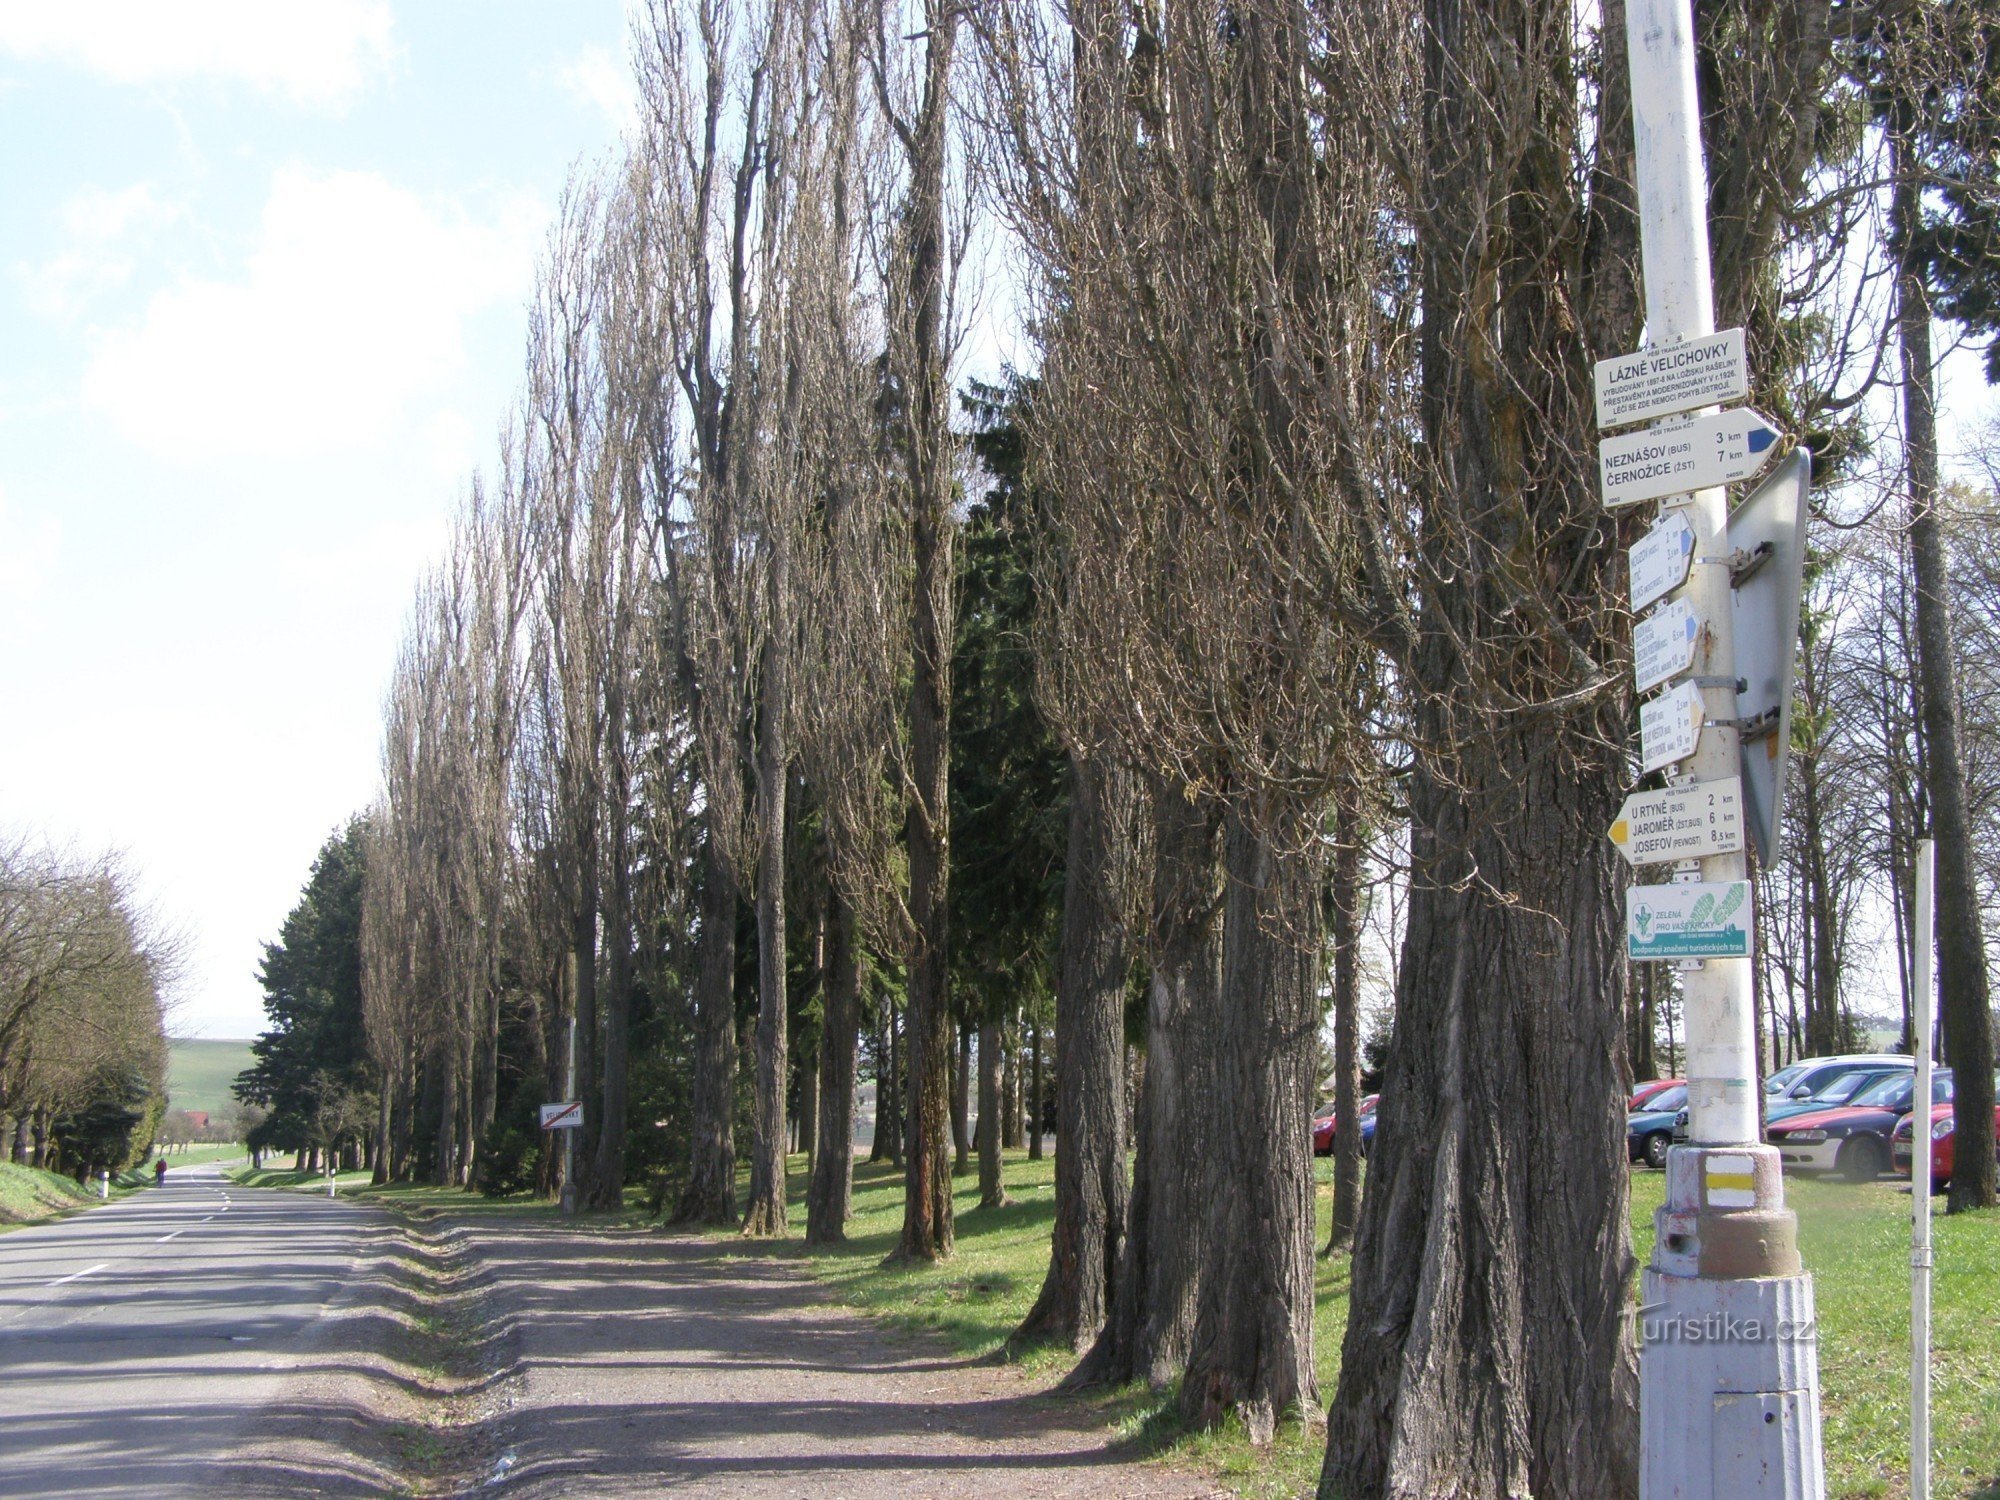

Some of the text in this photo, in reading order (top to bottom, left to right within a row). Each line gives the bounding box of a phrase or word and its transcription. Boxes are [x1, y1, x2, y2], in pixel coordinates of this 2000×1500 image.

[1609, 342, 1729, 384] LÁZNĚ VELICHOVKY
[1602, 381, 1645, 397] VYBUDOVÁNY
[1666, 374, 1676, 382] NA
[1676, 366, 1704, 380] LOŽISKU
[1705, 358, 1738, 372] RAŠELINY
[1646, 389, 1652, 397] A
[1651, 376, 1707, 396] MODERNIZOVÁNY
[1628, 403, 1637, 411] SE
[1637, 400, 1652, 409] ZDE
[1663, 425, 1682, 434] TRASA
[1605, 431, 1742, 469] NEZNÁŠOV (BUS) 3 km
[1606, 450, 1743, 487] ČERNOŽICE (ŽST) 7 km
[1631, 793, 1733, 819] U RTYNĚ (BUS) 2 km
[1632, 815, 1674, 837] JAROMĚŘ
[1709, 812, 1716, 824] 6
[1723, 813, 1735, 822] km
[1633, 836, 1673, 854] JOSEFOV
[1673, 836, 1702, 849] (PEVNOST)
[1711, 829, 1724, 843] 8,5
[1724, 831, 1736, 840] km
[1655, 910, 1682, 920] ZELENÁ
[1656, 921, 1715, 931] PRO VAŠE KROKY
[1663, 944, 1689, 953] značení
[1689, 943, 1729, 953] turistických
[1729, 943, 1744, 951] tras
